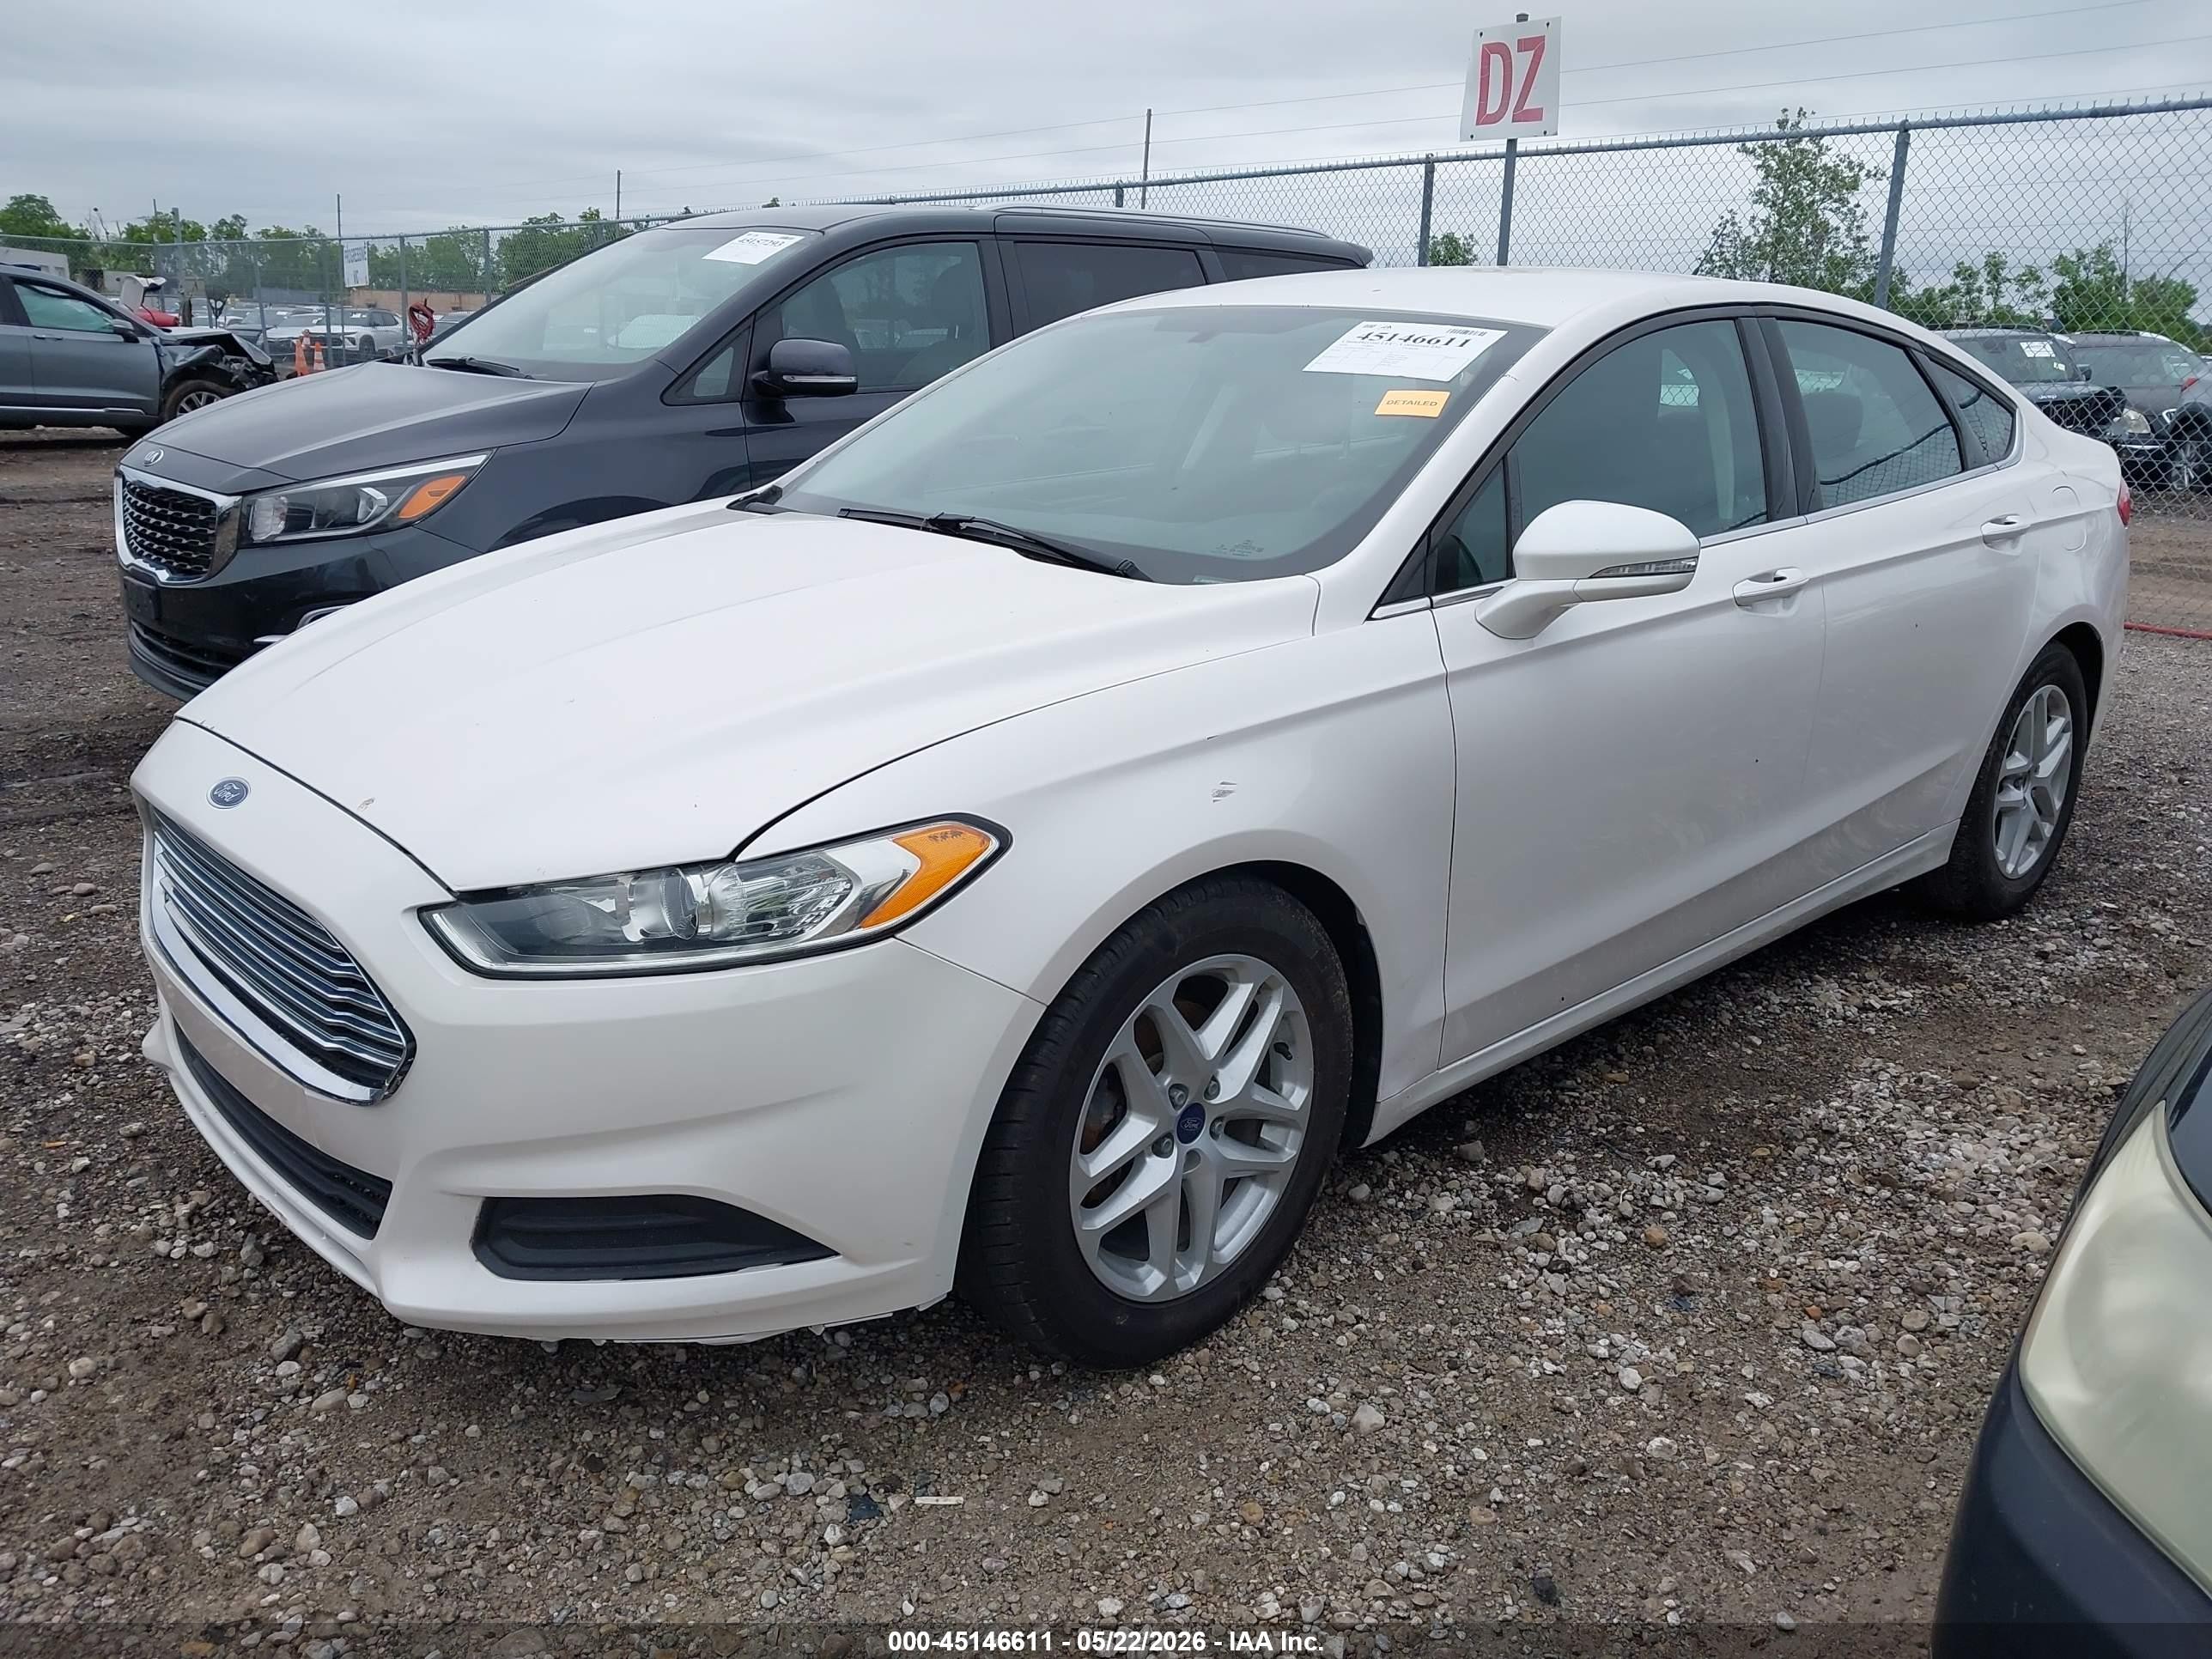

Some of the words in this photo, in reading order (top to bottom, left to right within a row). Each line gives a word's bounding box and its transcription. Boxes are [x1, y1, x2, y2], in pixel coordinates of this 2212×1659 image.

[1476, 35, 1546, 125] DZ
[1357, 331, 1471, 348] 45146611
[214, 782, 241, 802] Ford
